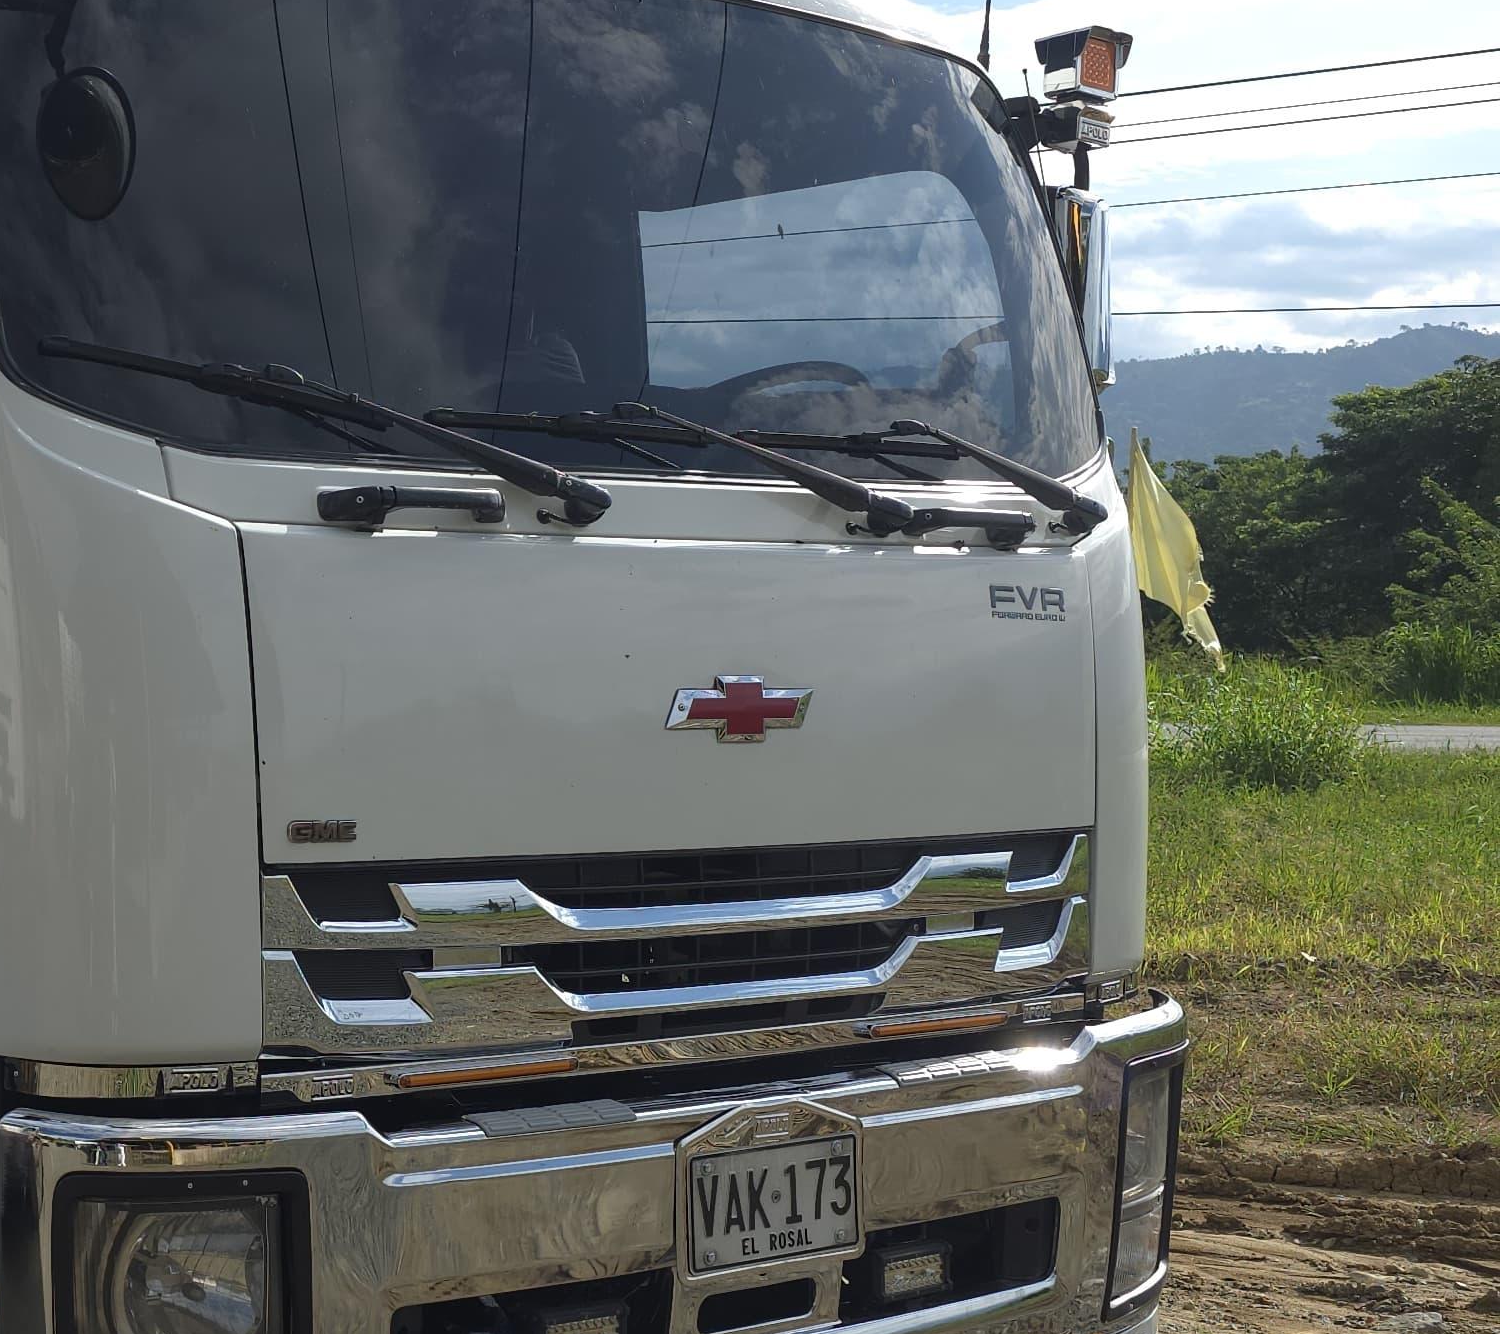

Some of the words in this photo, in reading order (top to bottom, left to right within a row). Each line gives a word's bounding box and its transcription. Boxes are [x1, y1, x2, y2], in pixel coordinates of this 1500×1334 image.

[1081, 123, 1108, 140] APOLO
[988, 585, 1066, 613] FVR
[287, 820, 356, 843] GME
[696, 1168, 771, 1238] VAK
[783, 1155, 852, 1226] 173
[742, 1237, 760, 1255] EL
[770, 1227, 813, 1252] ROSAL
